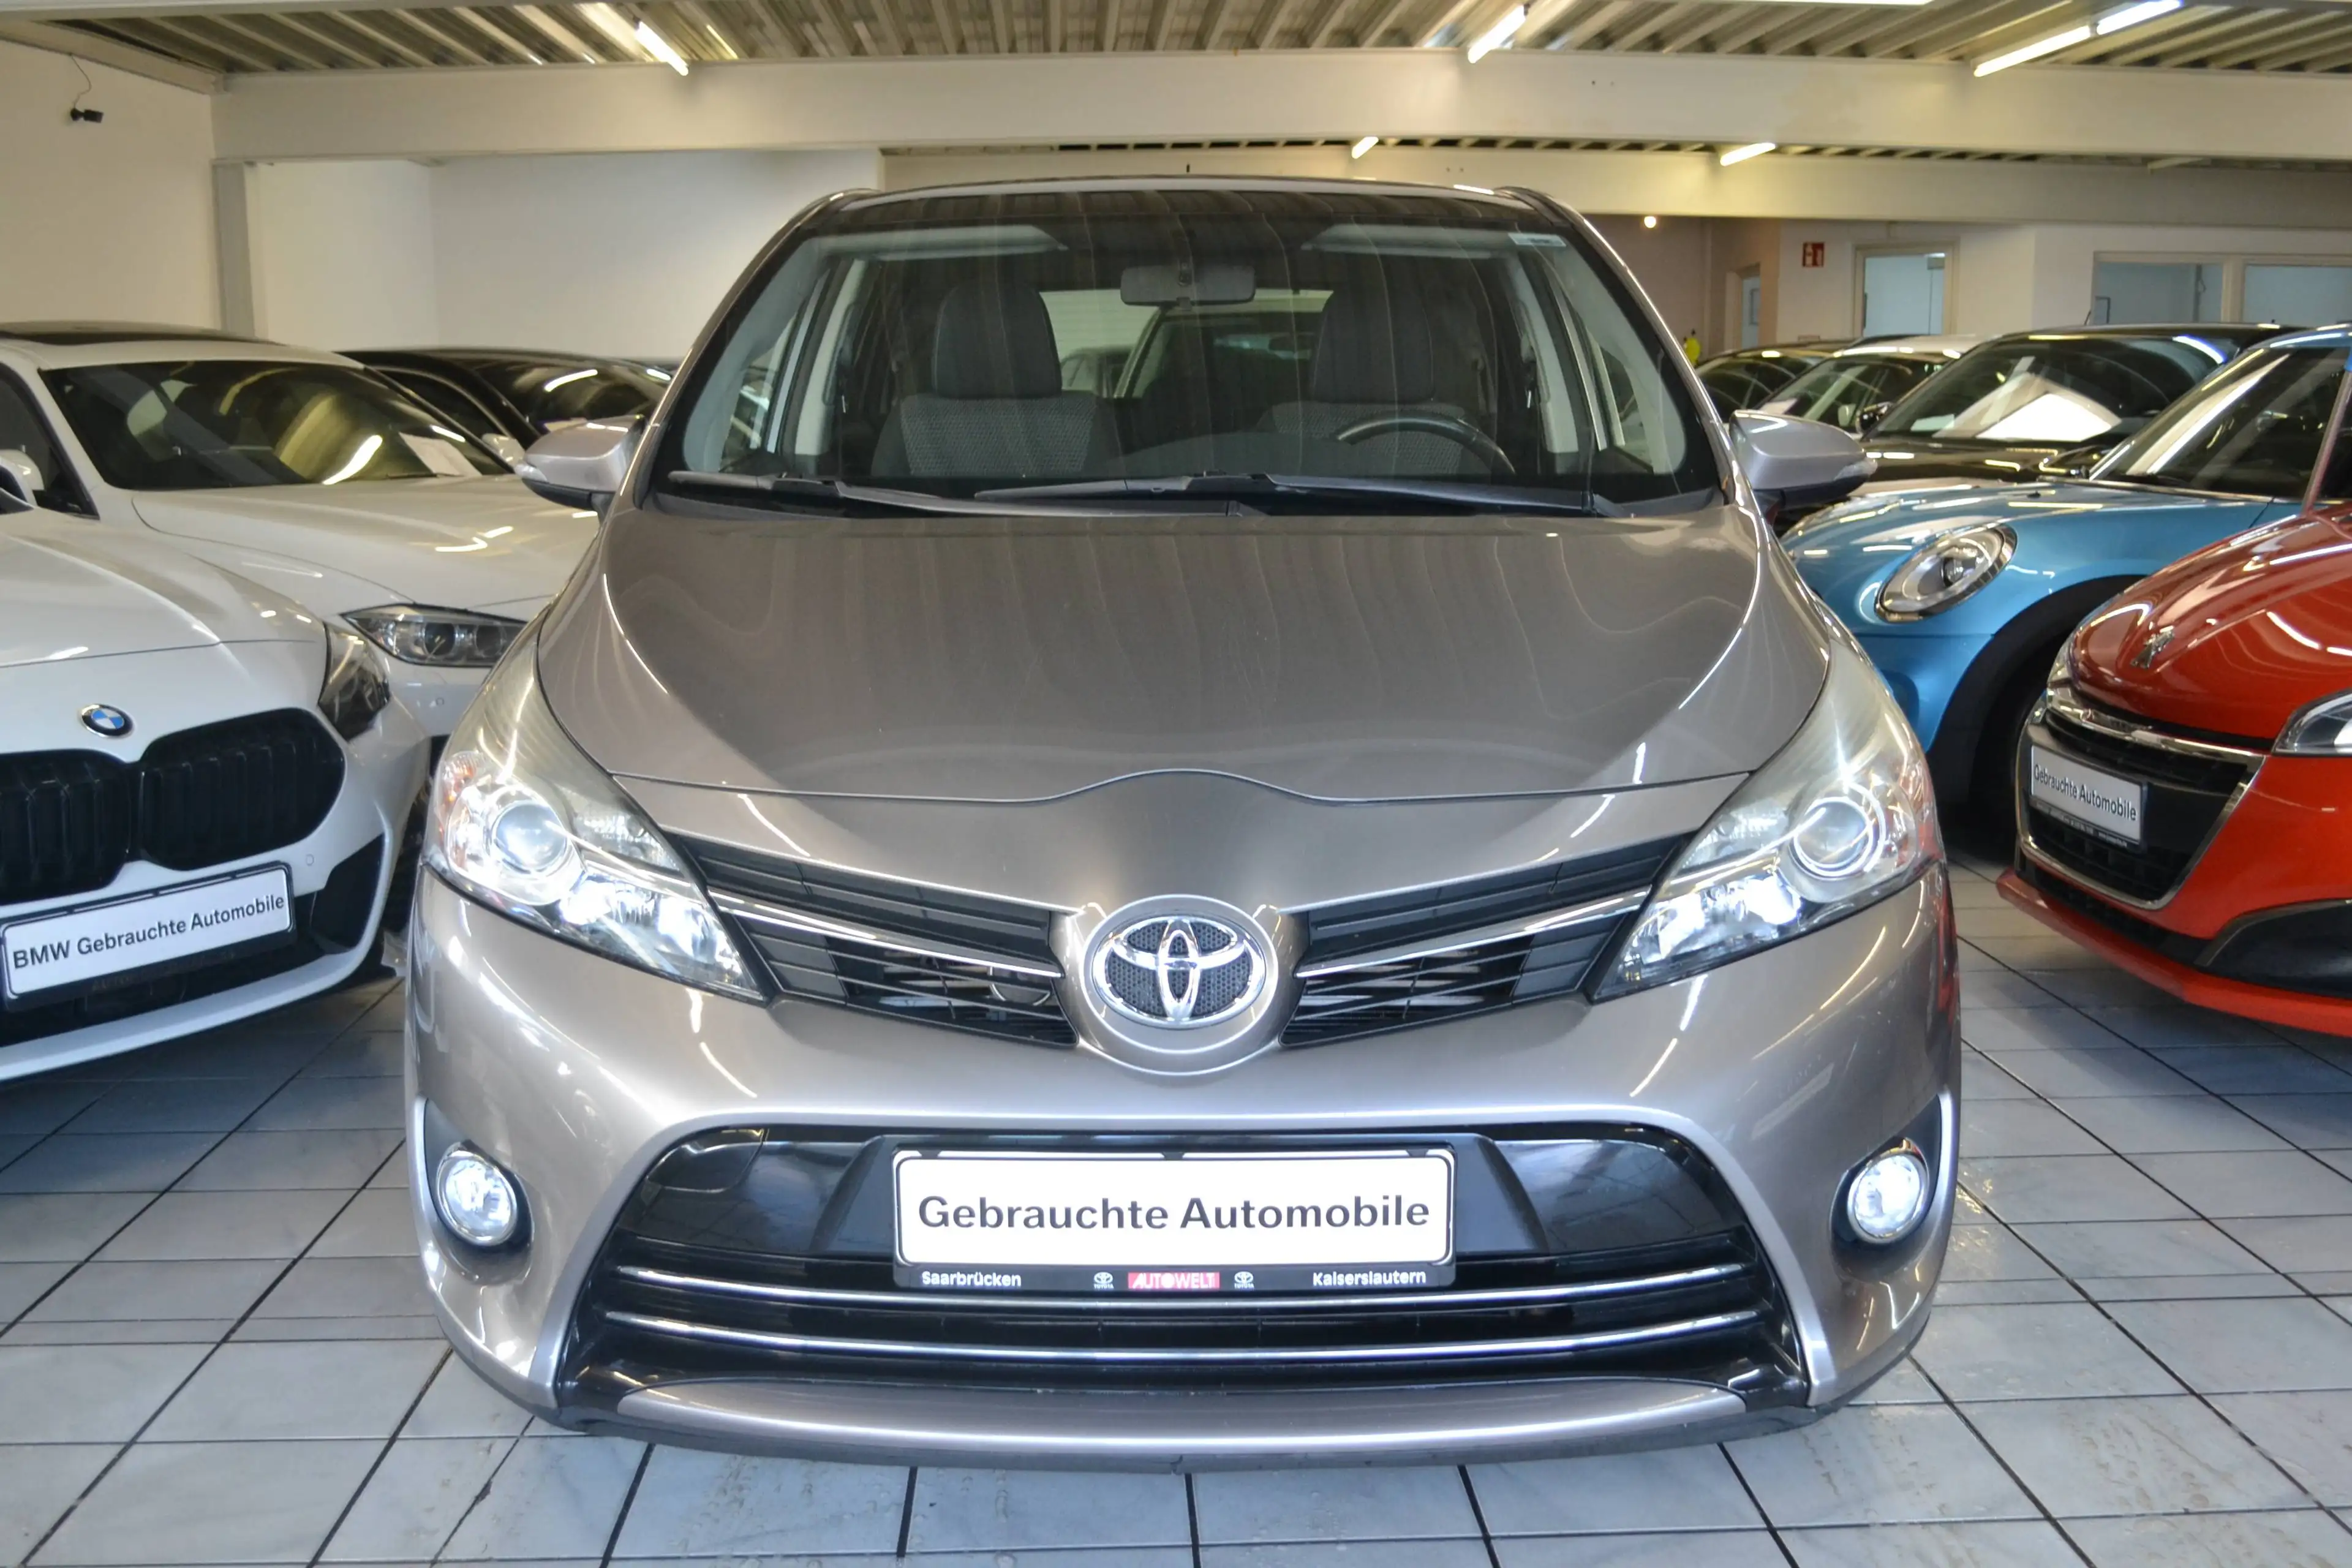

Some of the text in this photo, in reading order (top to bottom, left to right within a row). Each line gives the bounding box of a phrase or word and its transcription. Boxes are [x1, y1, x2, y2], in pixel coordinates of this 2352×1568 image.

[2034, 764, 2078, 799] Gebrauchte
[2079, 784, 2136, 821] Automobile
[13, 894, 284, 969] BMW Gebrauchte Automobile
[918, 1194, 1430, 1230] Gebrauchte Automobile
[921, 1270, 1022, 1286] Saarbrücken
[1313, 1270, 1427, 1286] Kaiserslautern
